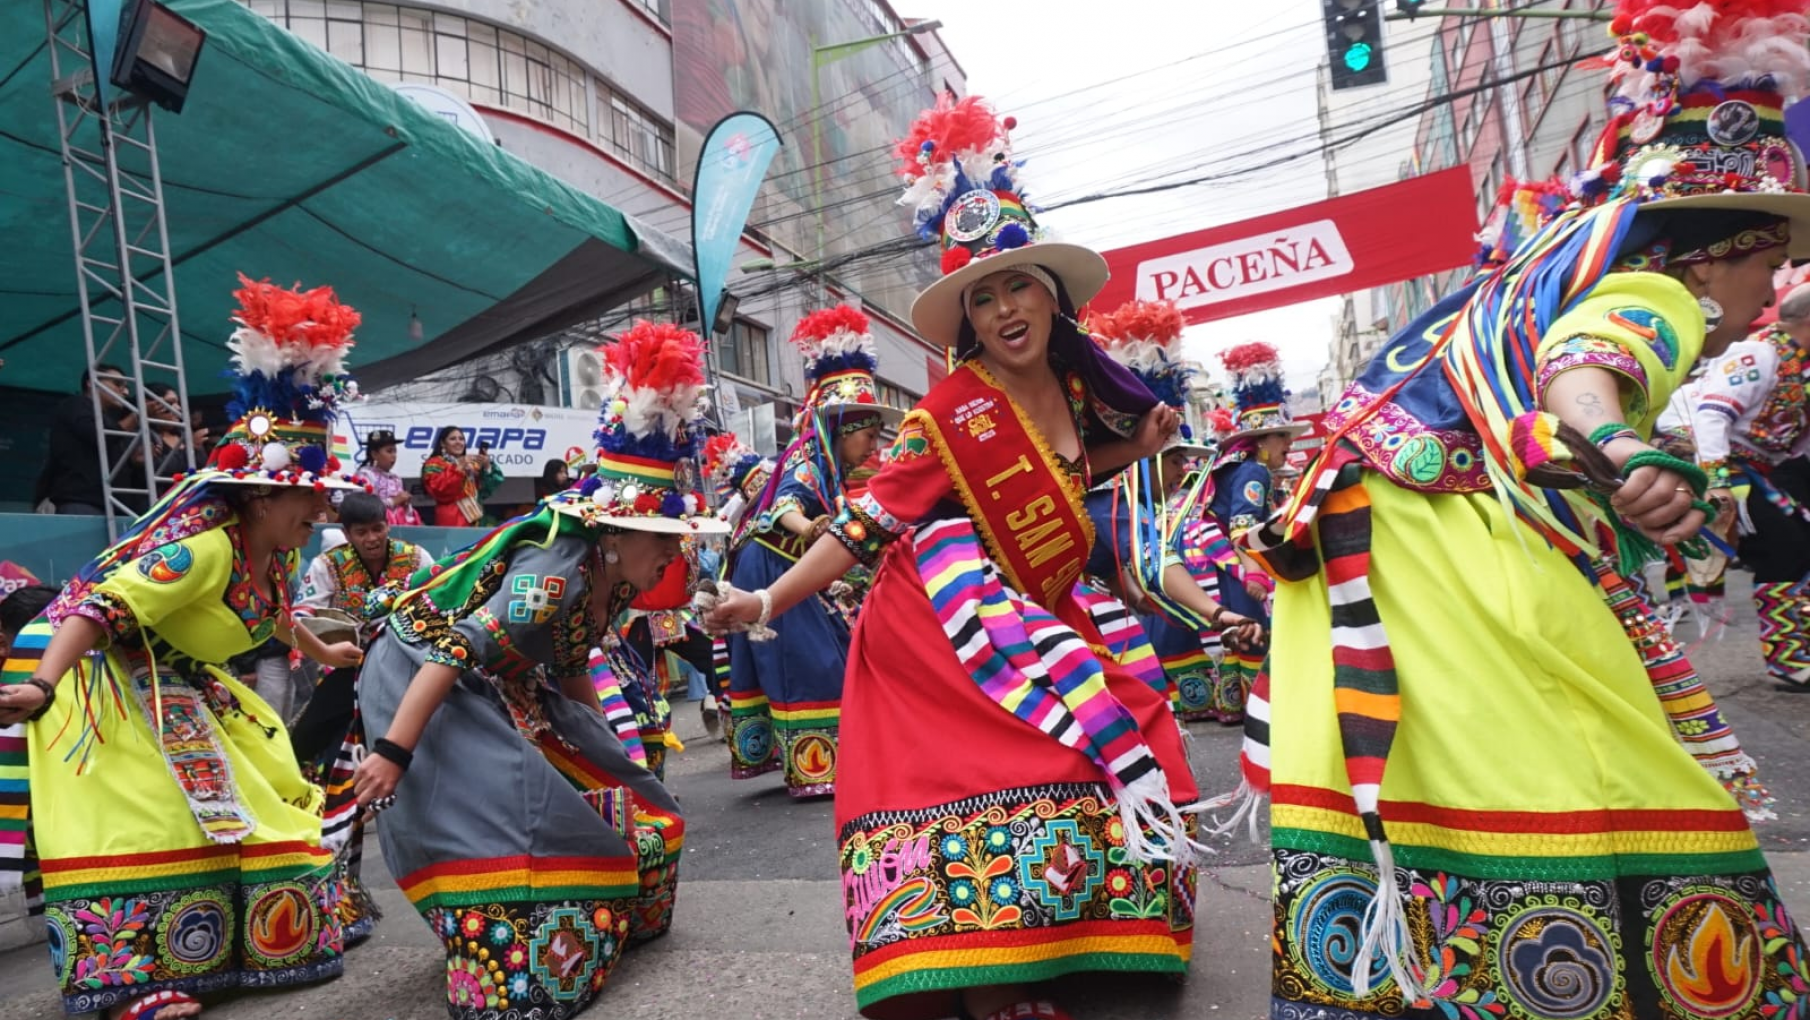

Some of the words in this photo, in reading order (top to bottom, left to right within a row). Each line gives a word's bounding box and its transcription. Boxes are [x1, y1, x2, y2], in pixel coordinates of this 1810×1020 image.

[1149, 236, 1336, 300] PACEÑA
[986, 454, 1033, 500] T.
[1006, 495, 1075, 569] SAN
